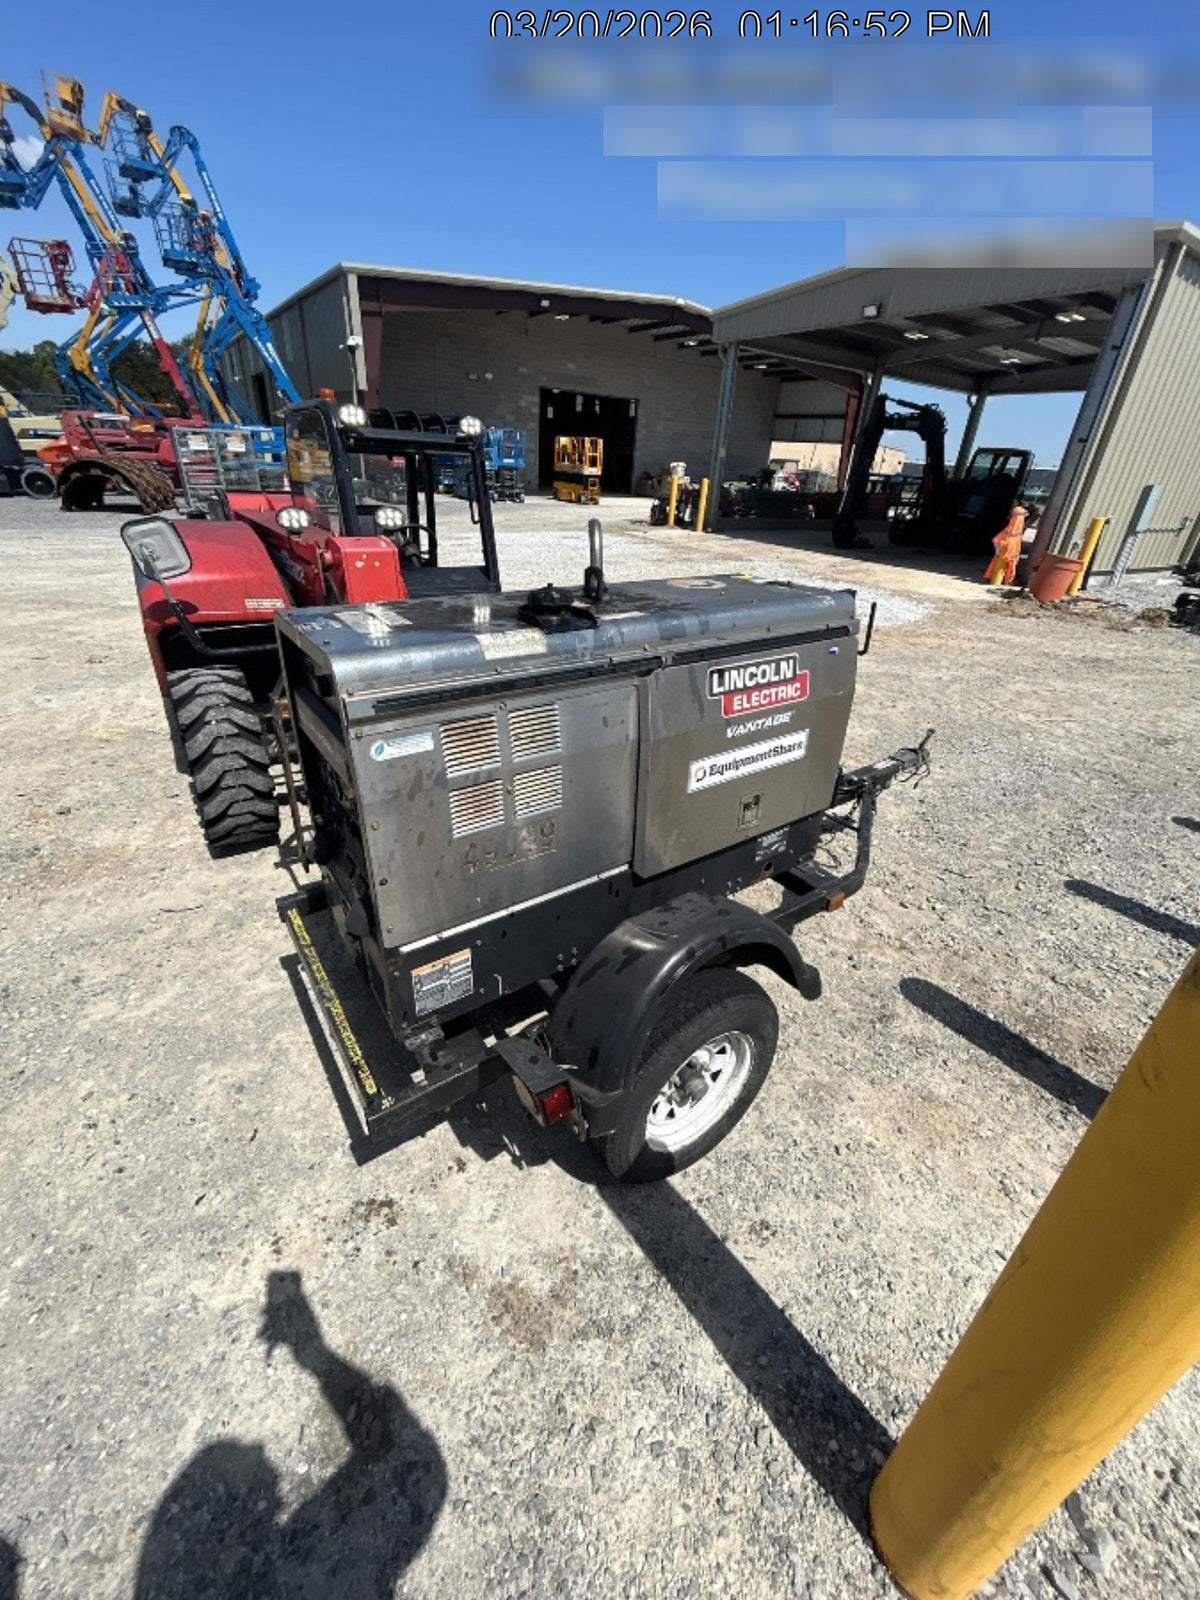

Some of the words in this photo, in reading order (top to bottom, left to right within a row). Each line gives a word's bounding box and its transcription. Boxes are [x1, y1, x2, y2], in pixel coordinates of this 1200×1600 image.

[712, 658, 794, 694] LINCOLN
[732, 682, 801, 711] ELECTRIC
[726, 711, 792, 738] VANTAGE
[708, 740, 804, 777] EquipmentShare
